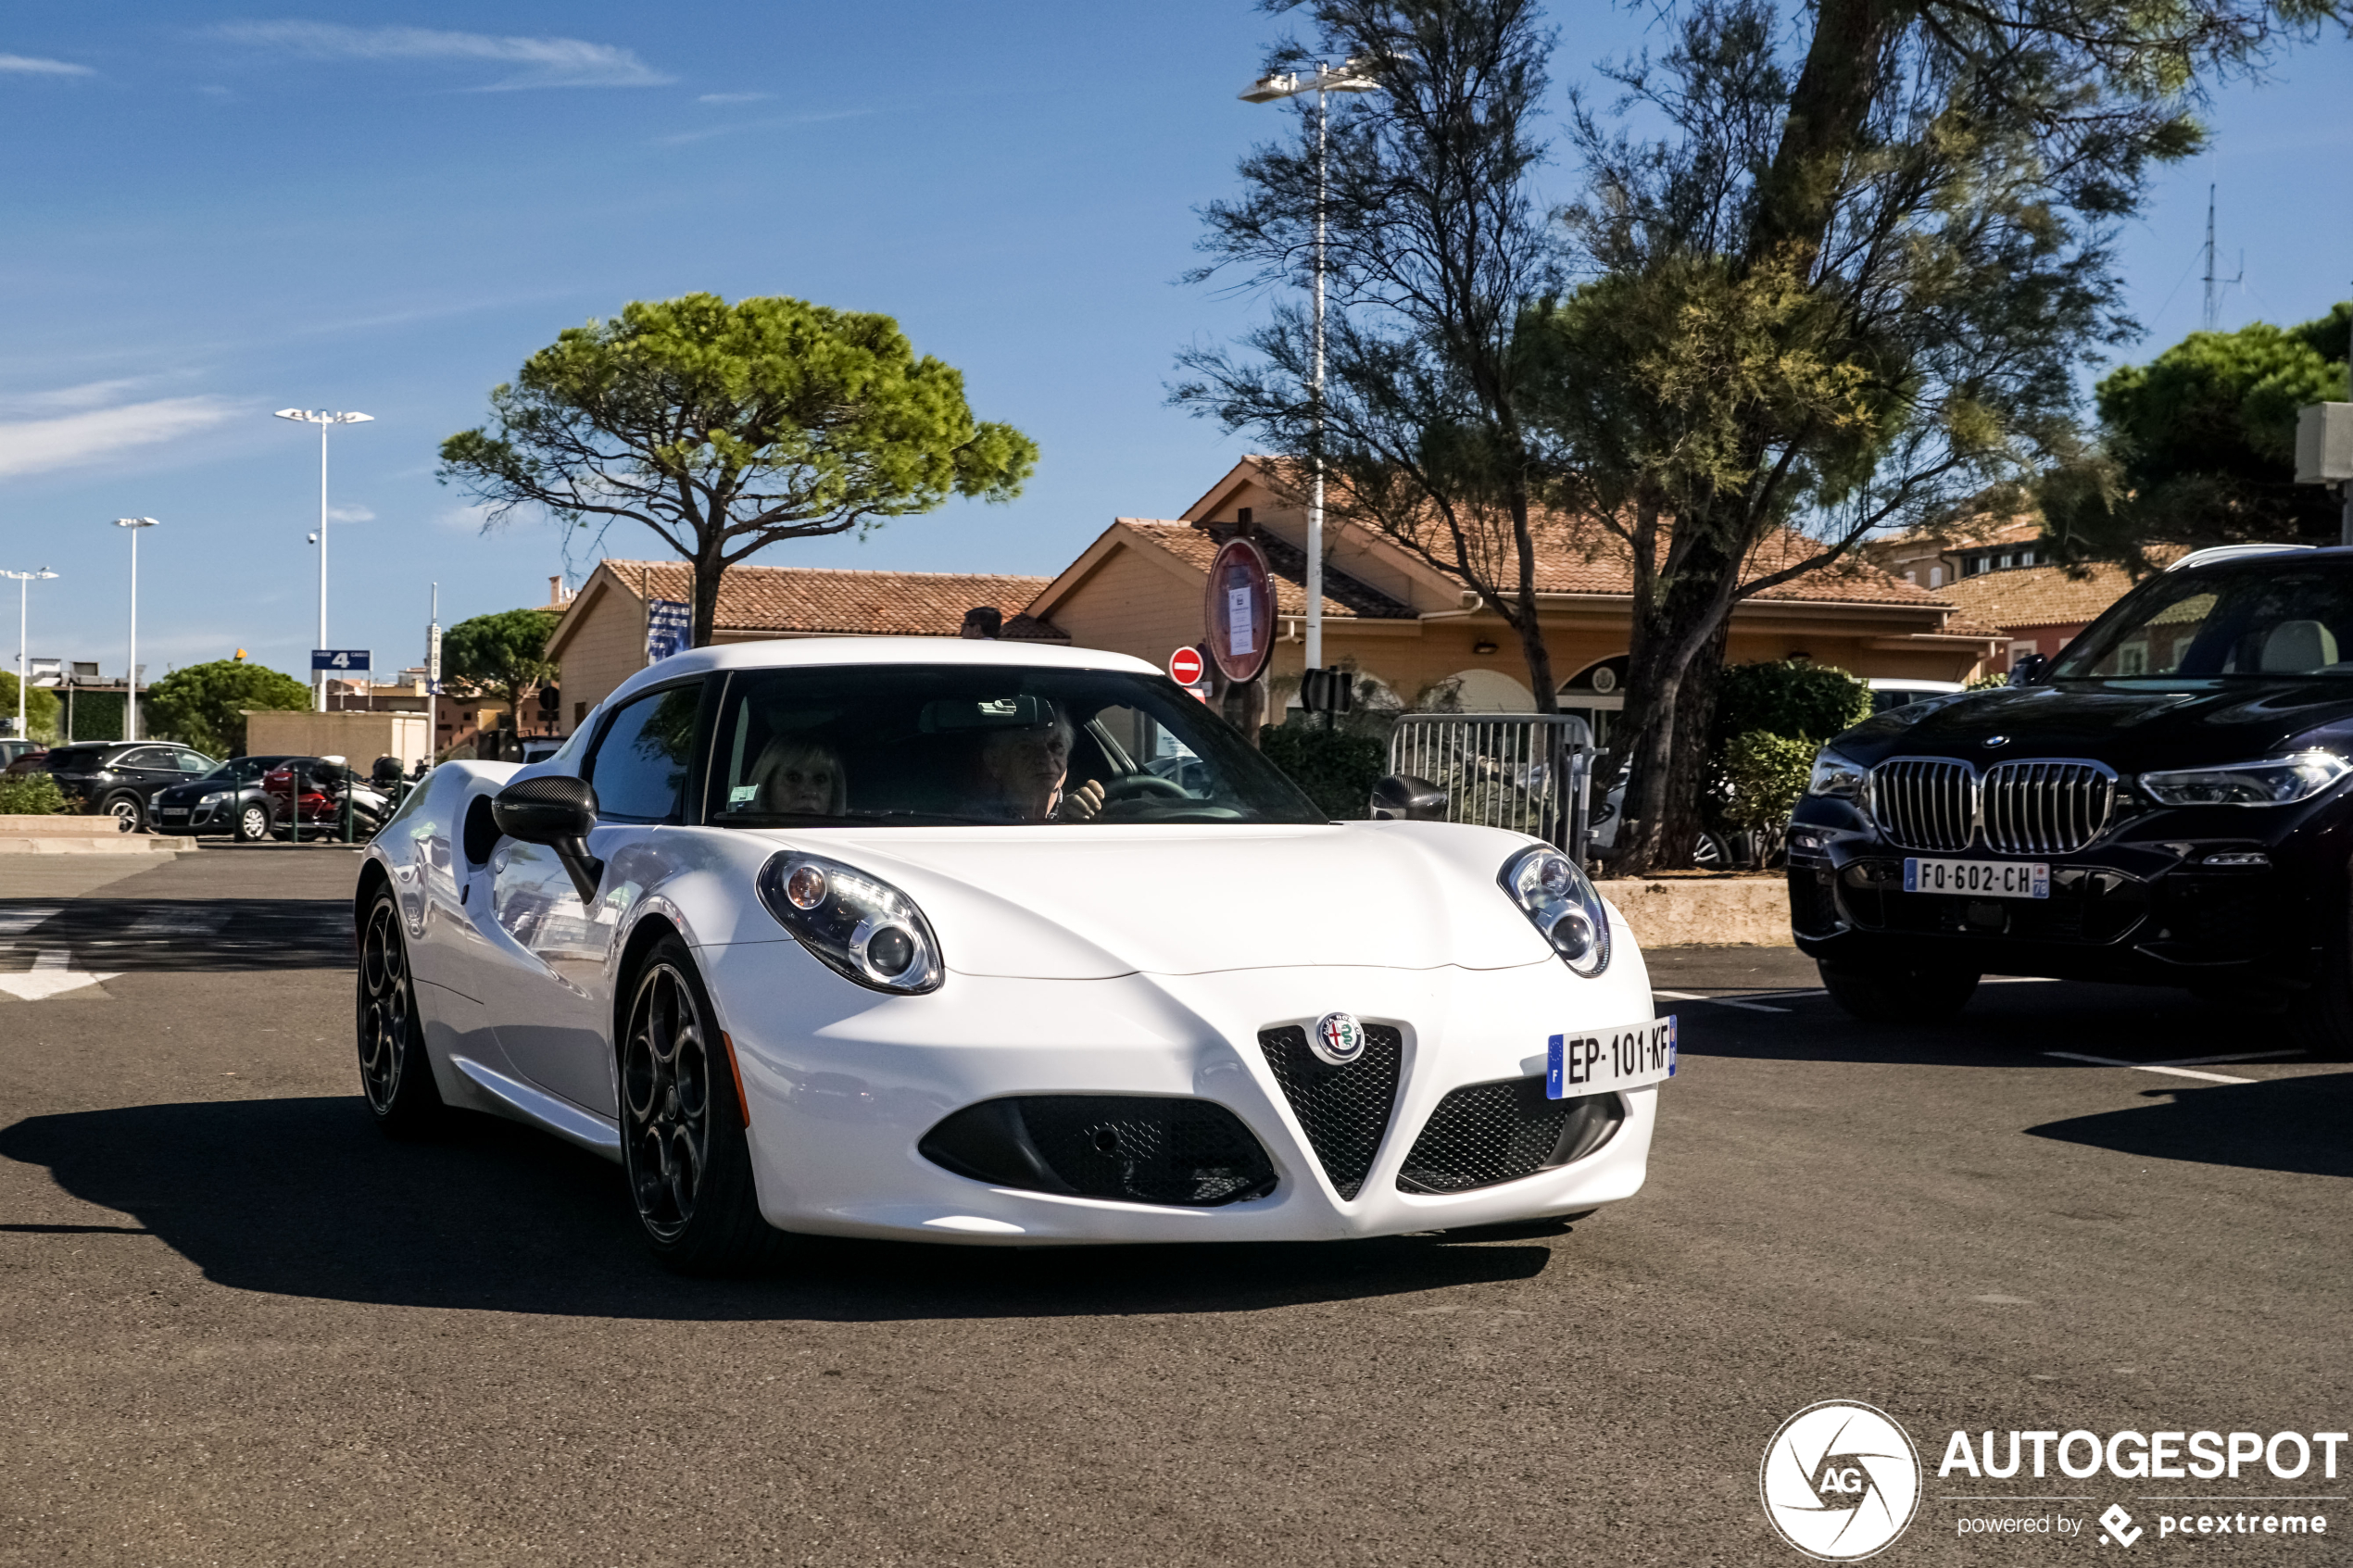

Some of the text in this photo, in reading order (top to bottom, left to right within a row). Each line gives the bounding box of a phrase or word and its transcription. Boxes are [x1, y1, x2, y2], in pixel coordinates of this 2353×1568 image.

[331, 652, 350, 669] 4
[431, 682, 439, 693] 4
[5, 718, 14, 727] 3
[1921, 863, 2031, 893] FQ-602-CH
[1568, 1024, 1668, 1085] EP-101-KF
[1552, 1069, 1559, 1084] F
